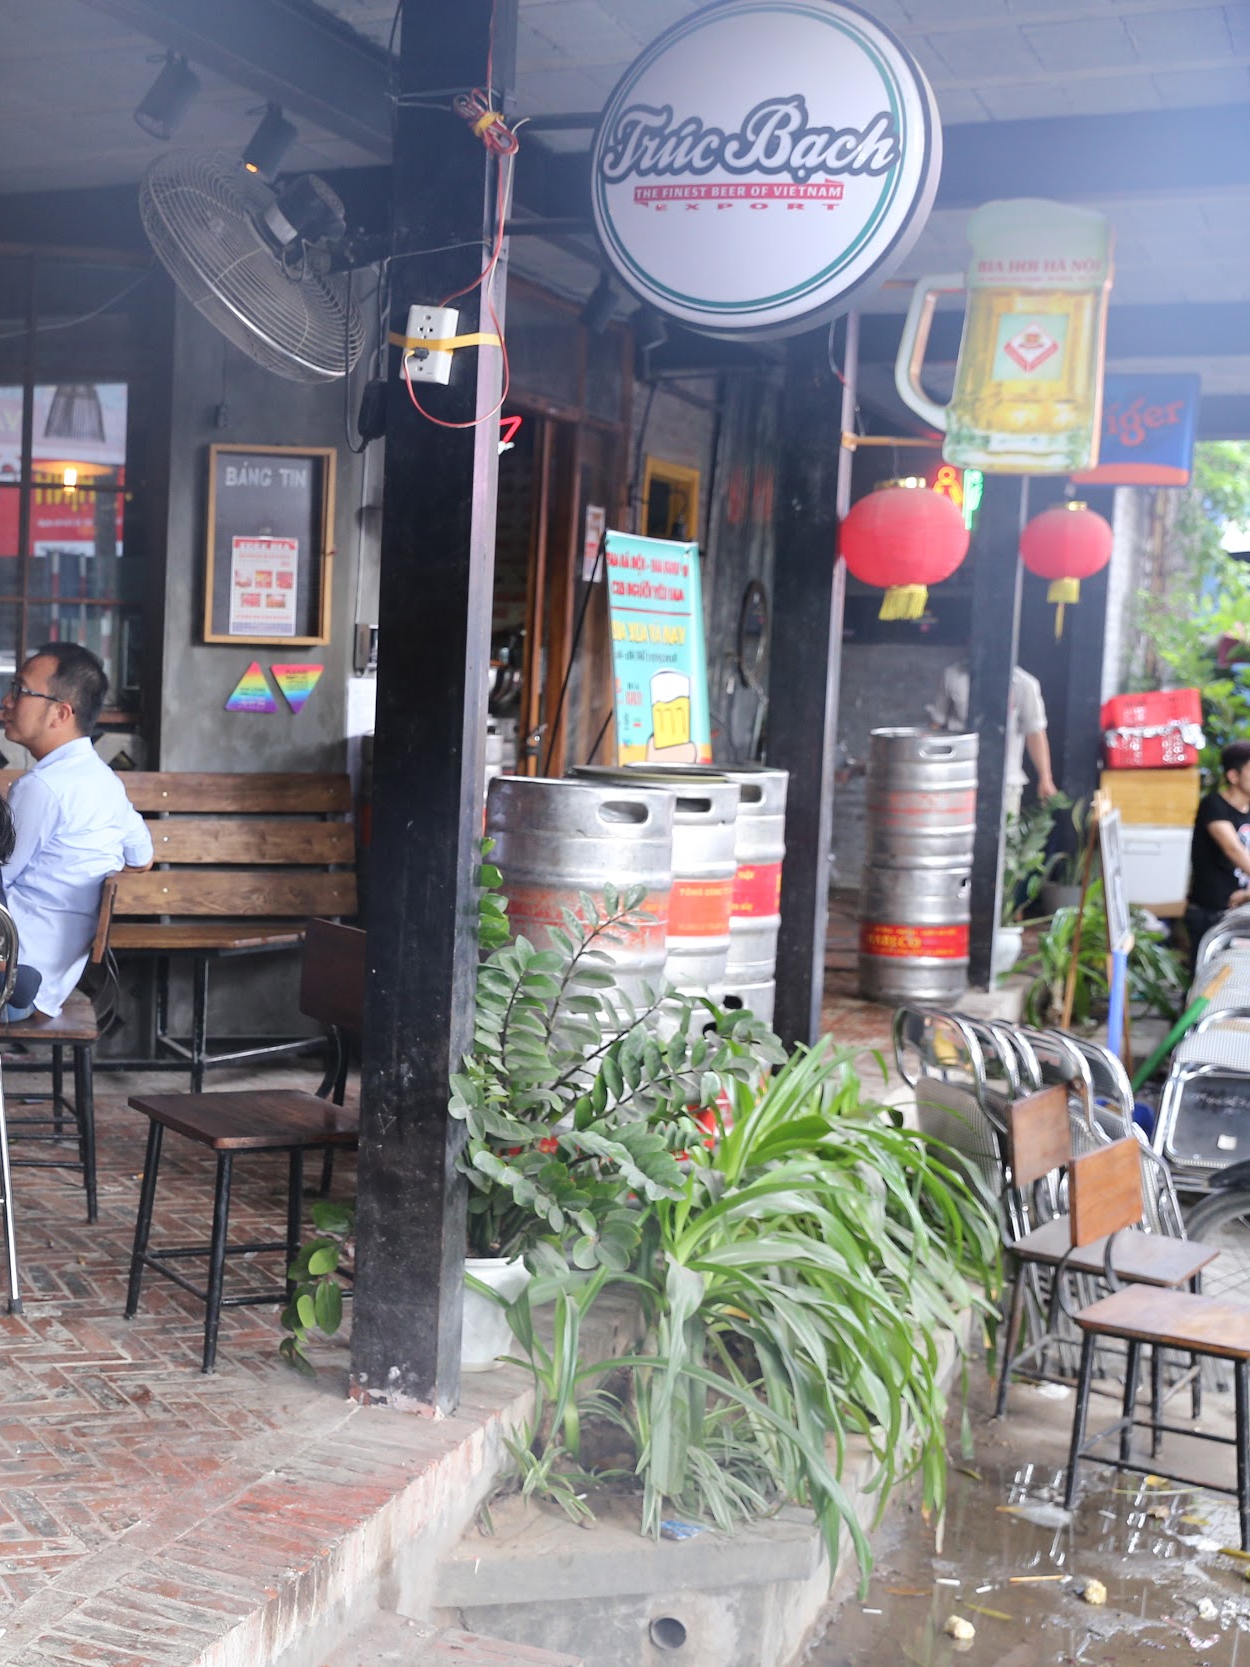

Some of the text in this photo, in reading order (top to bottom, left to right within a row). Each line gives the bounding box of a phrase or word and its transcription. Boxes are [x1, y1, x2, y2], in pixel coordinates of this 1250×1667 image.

[602, 94, 900, 184] Trúc Bạch
[635, 183, 843, 200] THE FINEST BEER OF VIETNAM
[654, 202, 841, 212] EXPORT
[1104, 395, 1185, 447] iger
[279, 468, 307, 488] TIN
